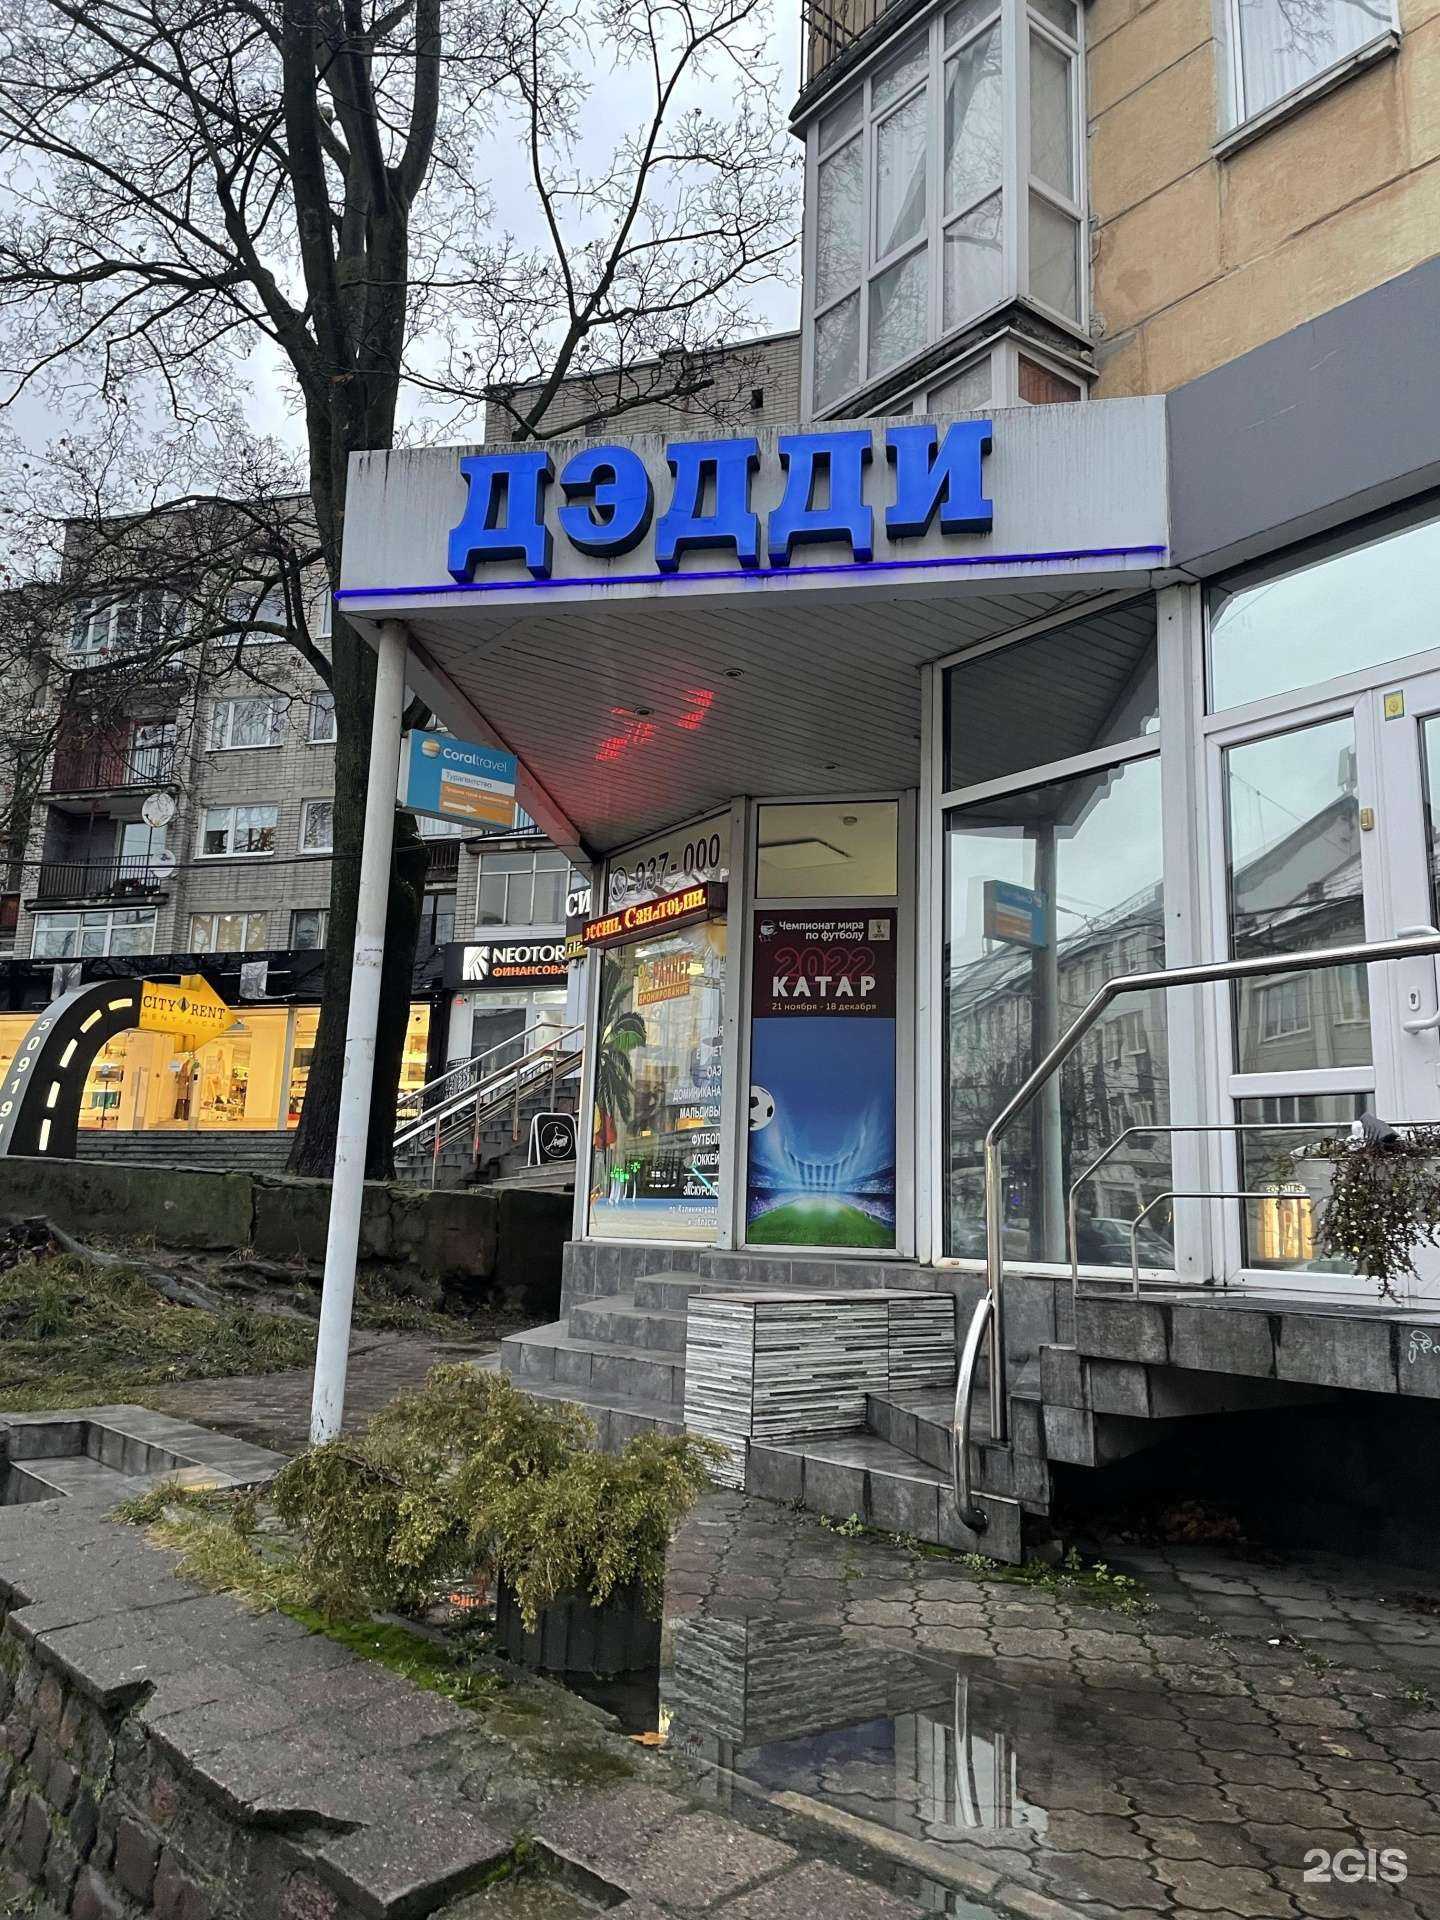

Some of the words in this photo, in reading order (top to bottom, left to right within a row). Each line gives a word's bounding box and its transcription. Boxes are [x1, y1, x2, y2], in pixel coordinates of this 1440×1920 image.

[447, 419, 993, 583] ДЭДДИ
[778, 921, 836, 931] Чемпионат
[837, 921, 865, 932] мира
[805, 932, 819, 941] по
[820, 930, 865, 942] футболу
[774, 946, 876, 985] 2022
[772, 975, 877, 998] КАТАР
[143, 995, 176, 1012] CITY
[190, 1003, 226, 1020] RENT
[771, 1002, 782, 1011] 21
[784, 1003, 818, 1012] ноября
[825, 1002, 837, 1011] 18
[838, 1002, 877, 1012] декабря
[706, 1065, 722, 1078] ОАЭ
[672, 1085, 721, 1103] ДОМИНИКАНА
[679, 1105, 721, 1120] МАЛЬДИВЫ
[691, 1132, 720, 1146] ФУТБОЛ
[691, 1150, 720, 1166] ХОККЕЙ
